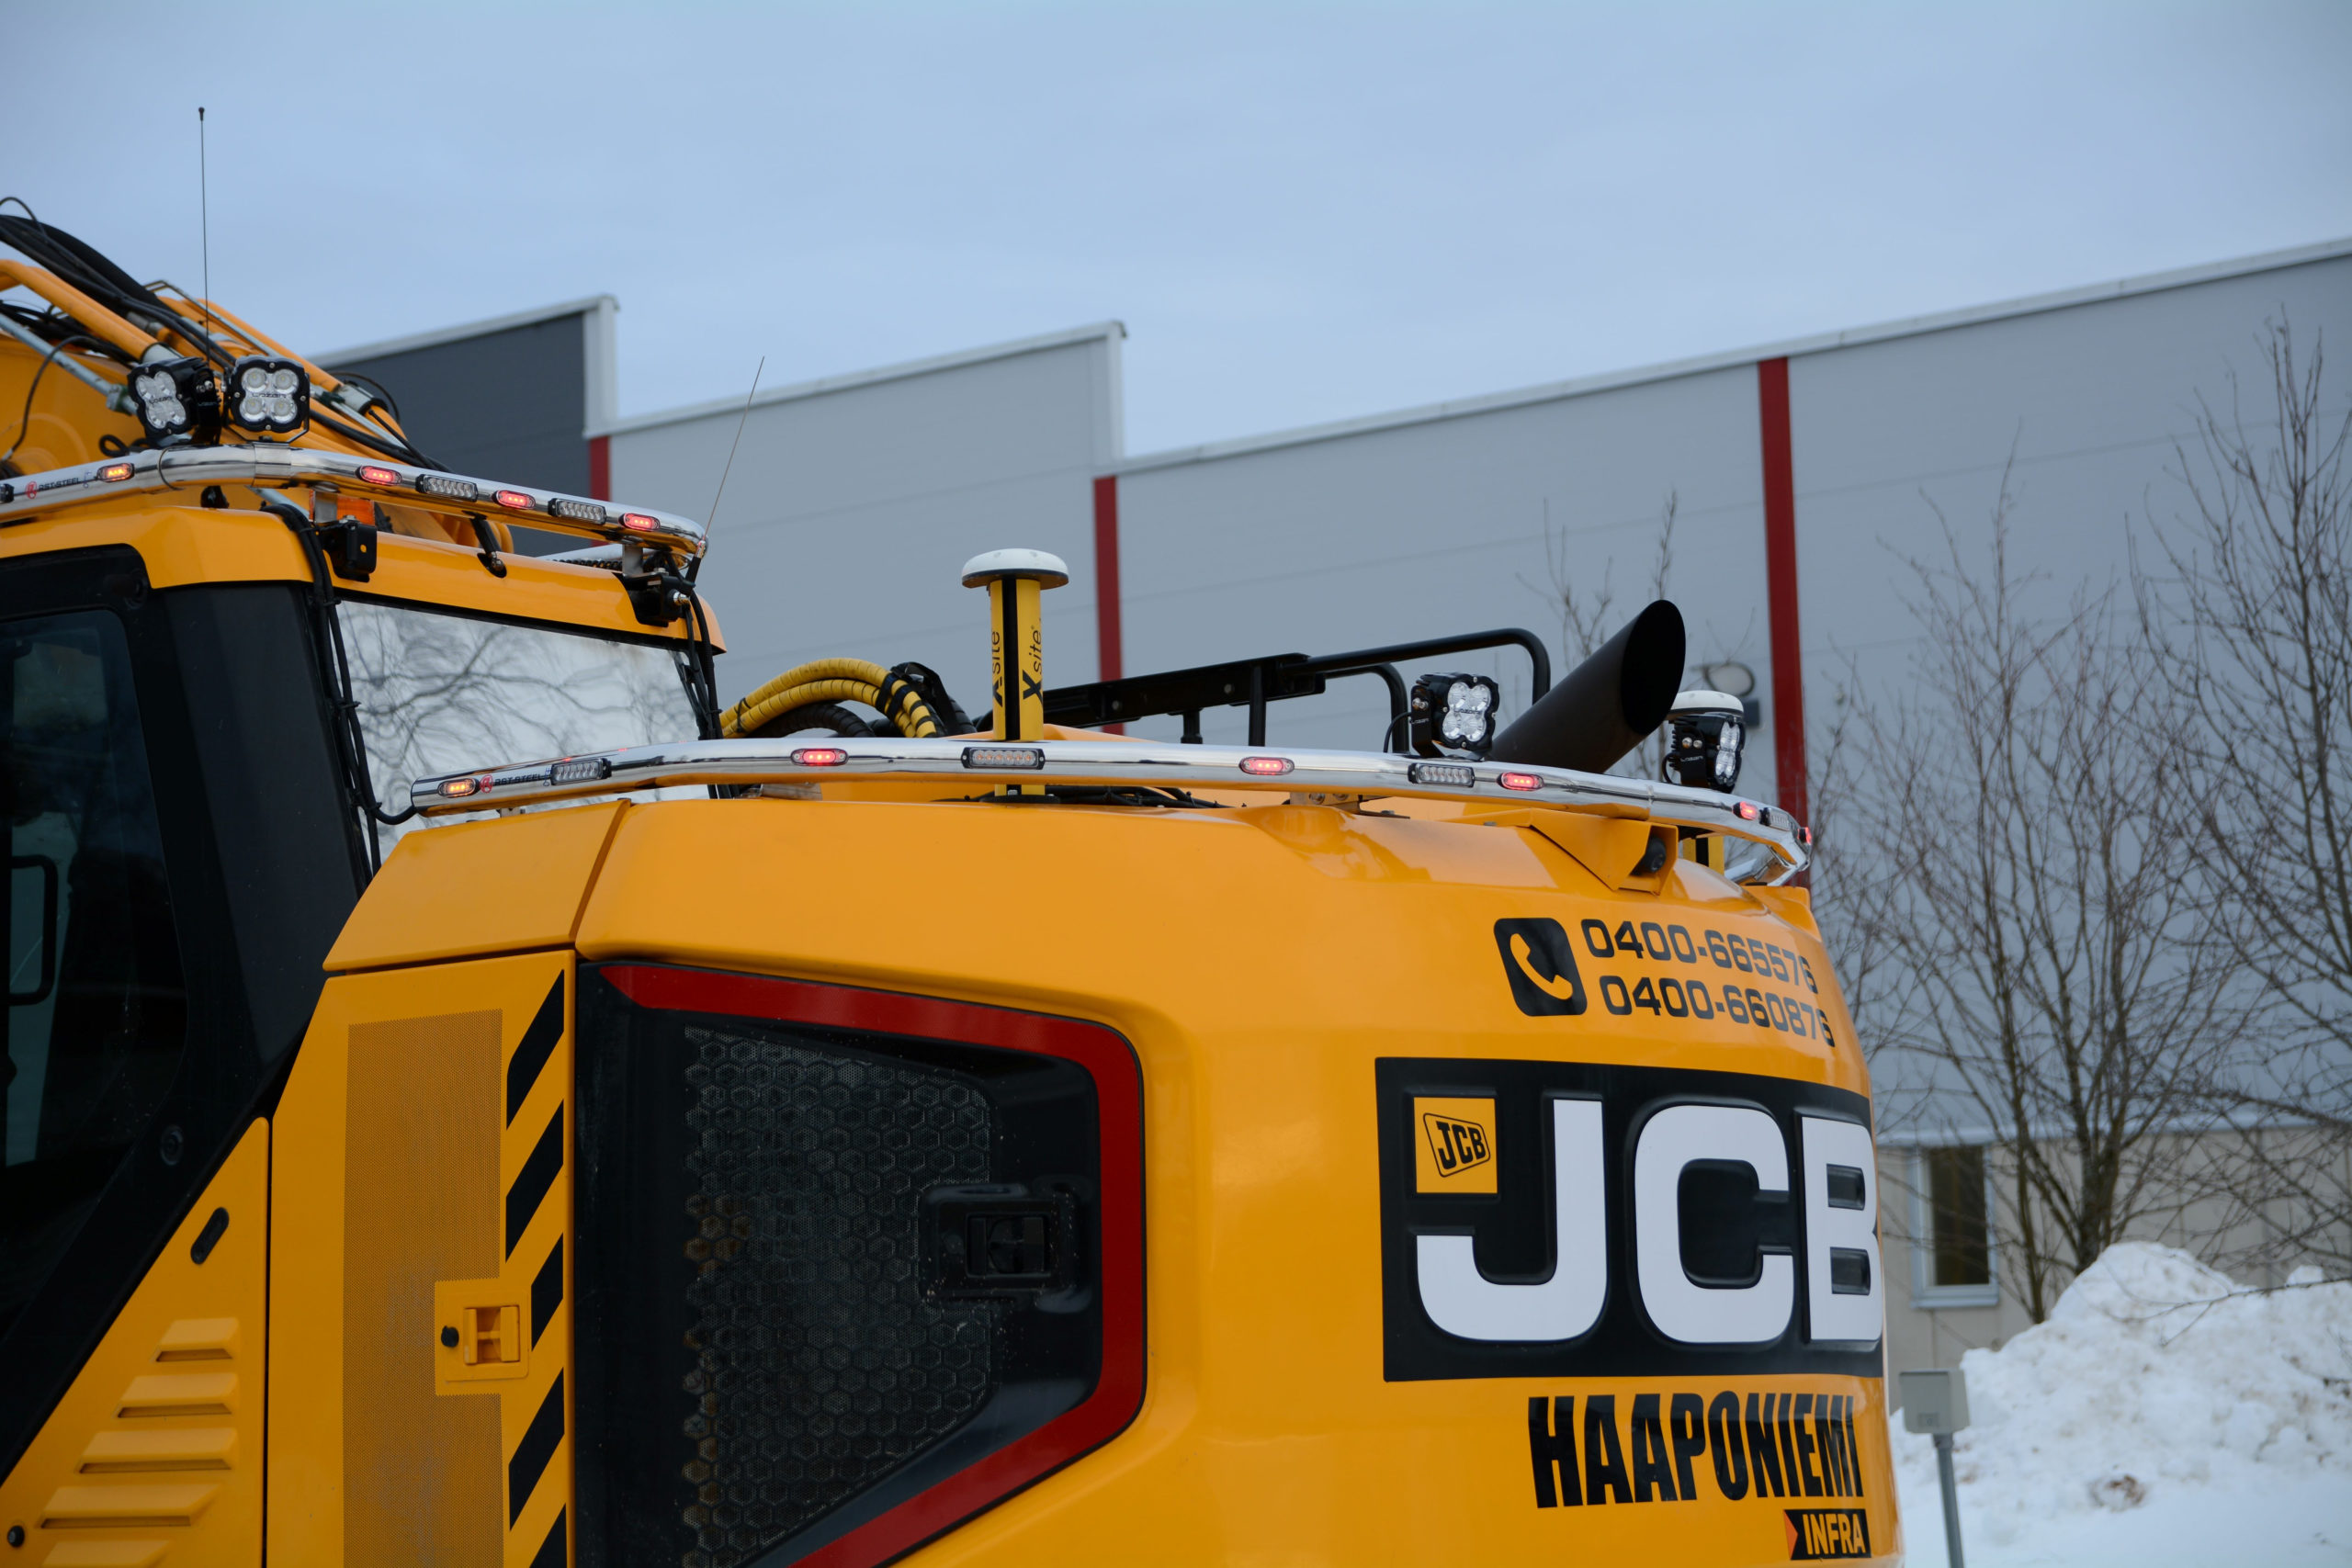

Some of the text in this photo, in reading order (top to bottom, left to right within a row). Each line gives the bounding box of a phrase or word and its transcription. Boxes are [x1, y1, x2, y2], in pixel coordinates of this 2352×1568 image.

[1581, 919, 1818, 994] 0400-665576
[1600, 976, 1836, 1047] 0400-660876
[1436, 1120, 1486, 1169] JCB
[1416, 1099, 1883, 1344] JCB
[1528, 1390, 1864, 1508] HAAPONIEMI
[1803, 1514, 1866, 1554] INFRA
